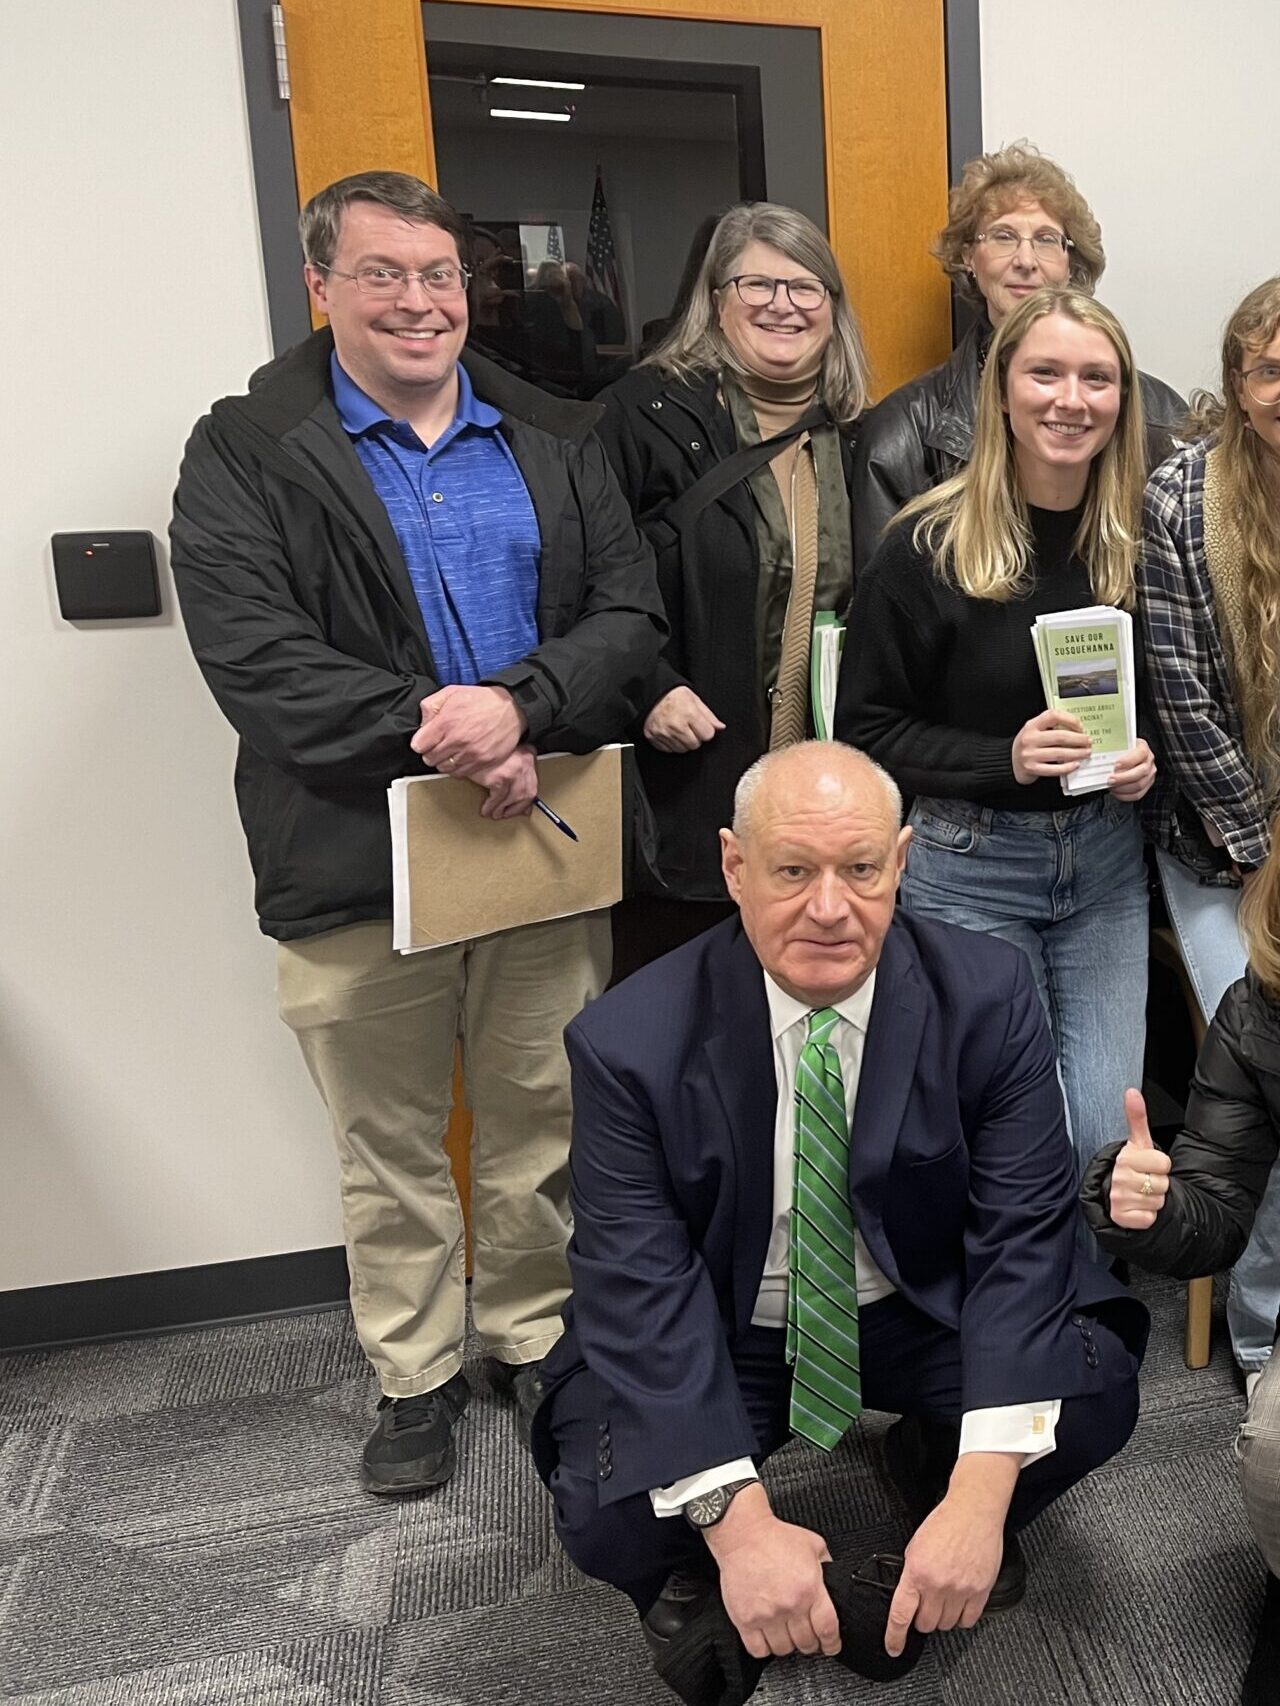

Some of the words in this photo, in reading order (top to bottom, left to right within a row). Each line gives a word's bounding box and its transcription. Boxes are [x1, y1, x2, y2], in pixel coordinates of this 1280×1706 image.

[1065, 634, 1085, 643] SAVE
[1088, 632, 1103, 641] OUR
[1054, 643, 1114, 656] SUSQUEHANNA
[1098, 703, 1115, 711] ABOUT
